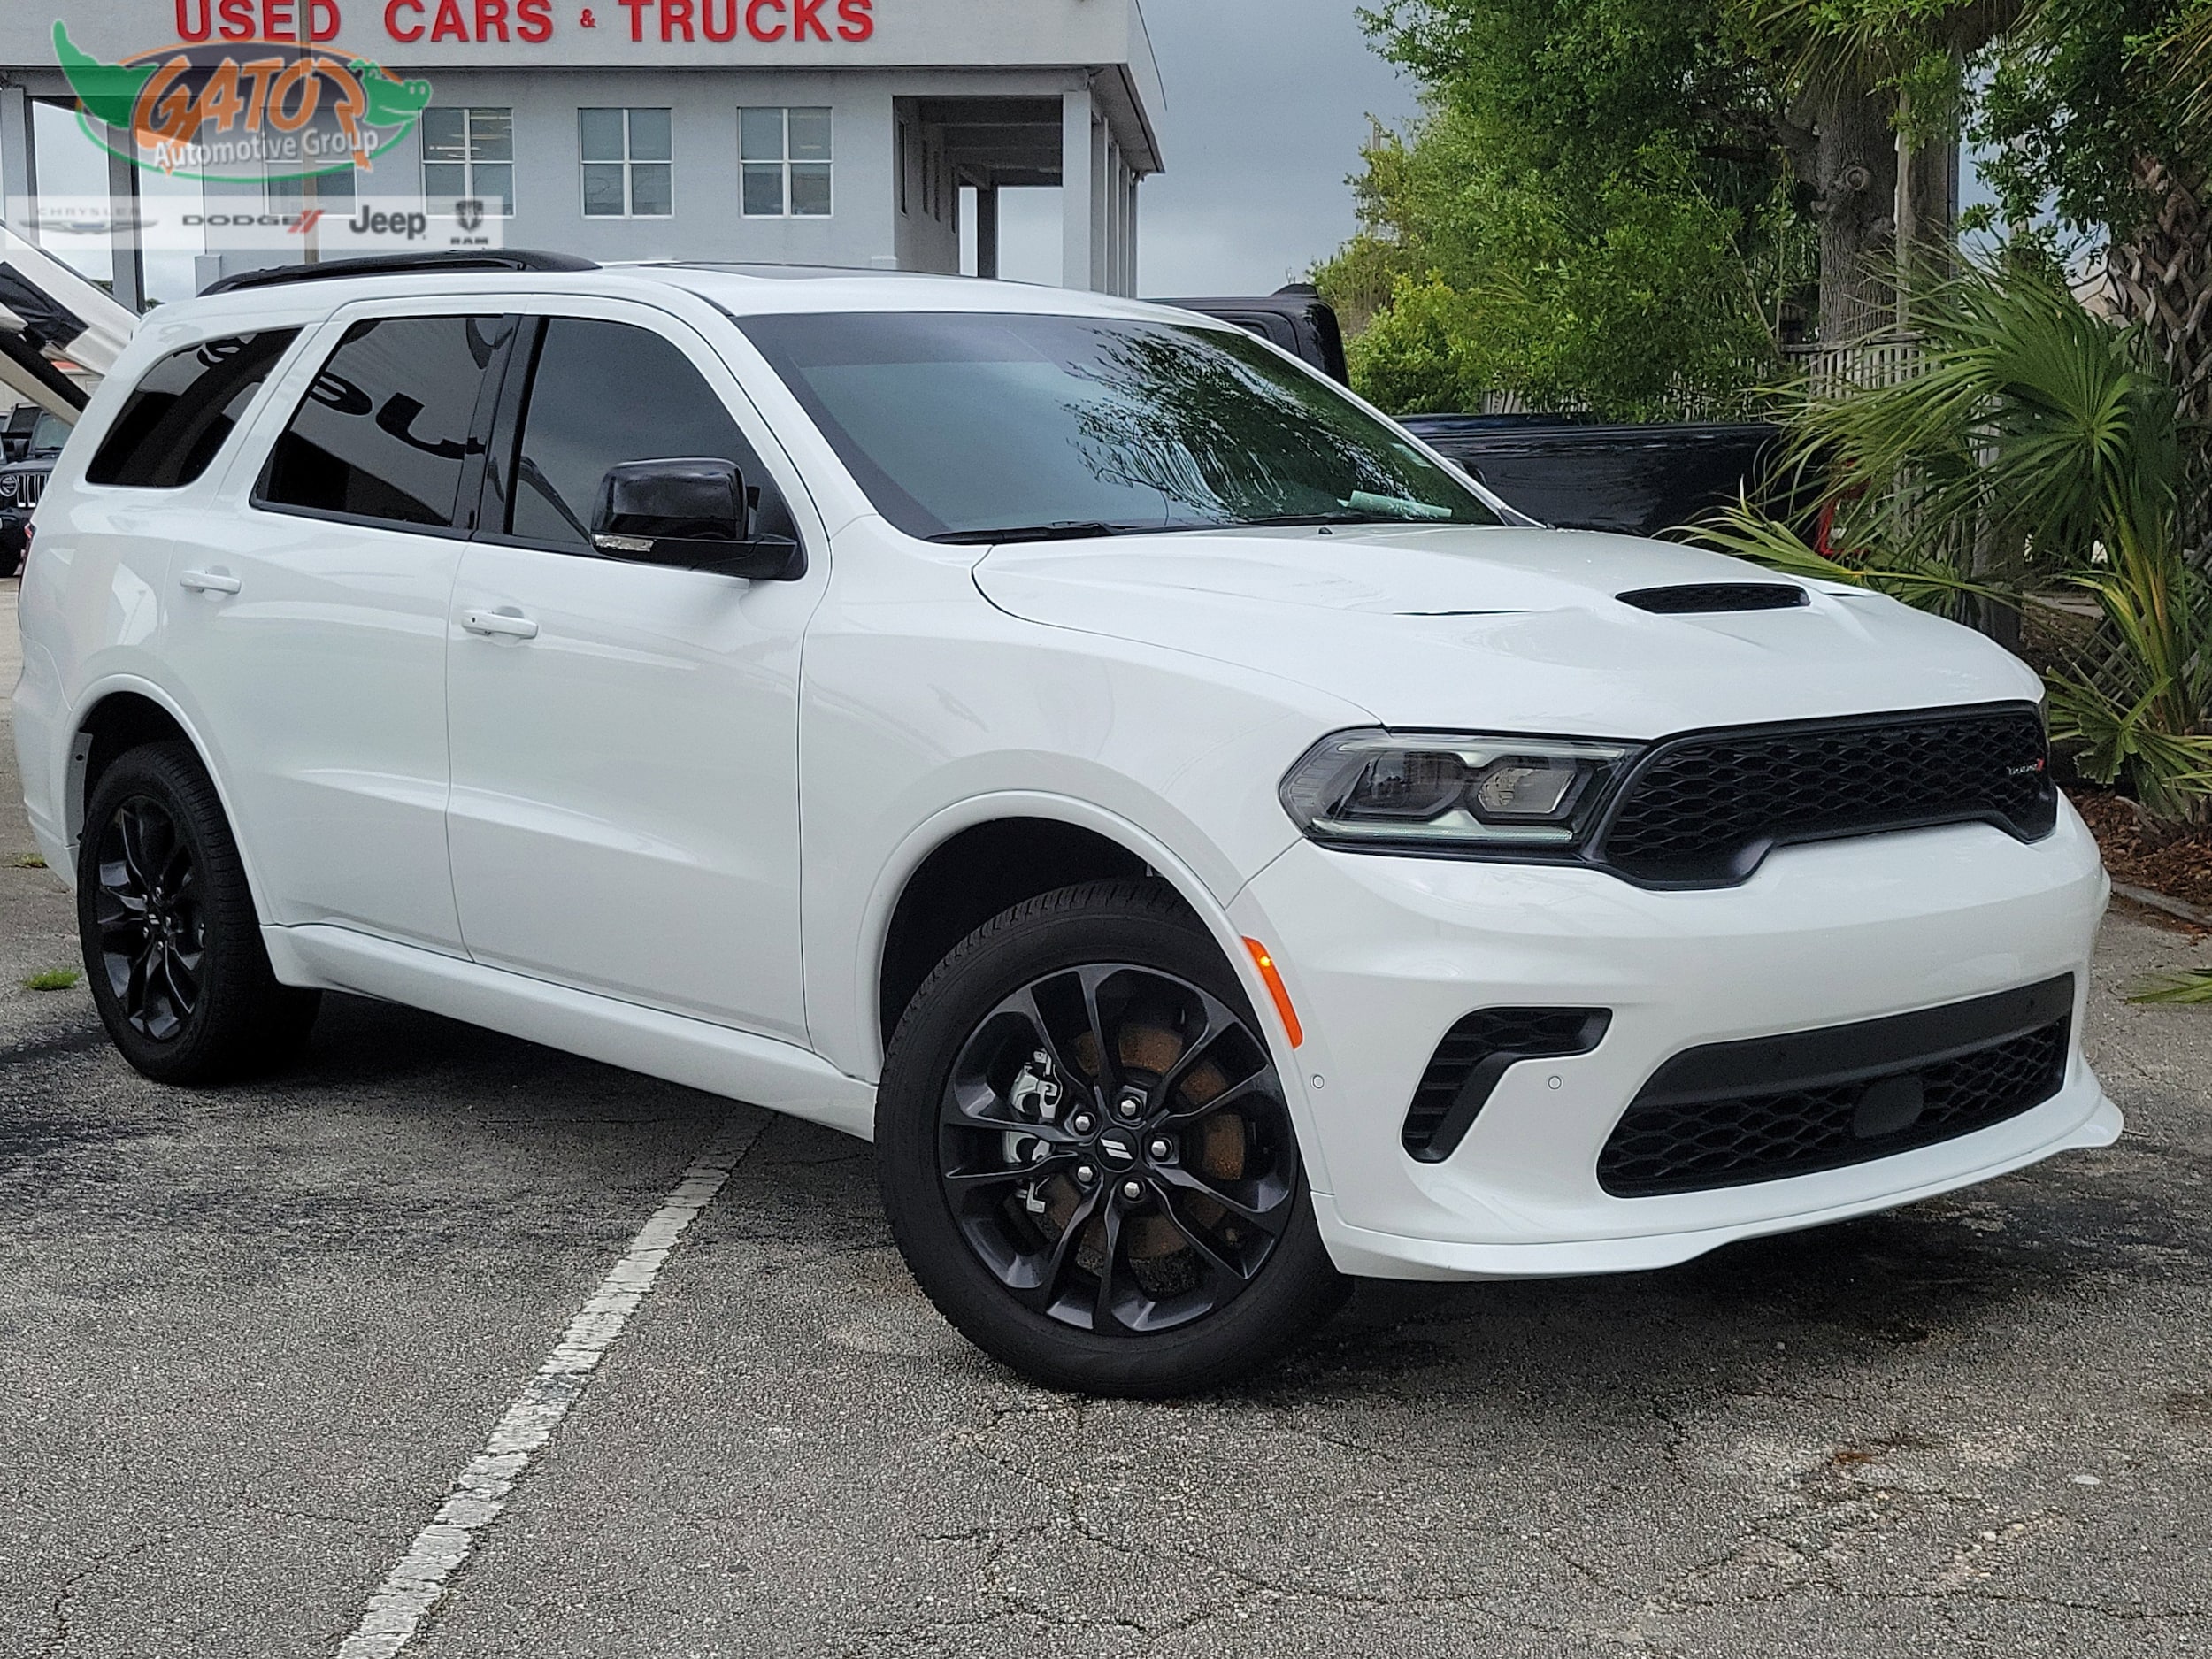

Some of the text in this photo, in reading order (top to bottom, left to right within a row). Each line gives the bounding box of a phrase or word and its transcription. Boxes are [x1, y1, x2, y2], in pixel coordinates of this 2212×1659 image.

[176, 0, 875, 42] USED CARS & TRUCKS
